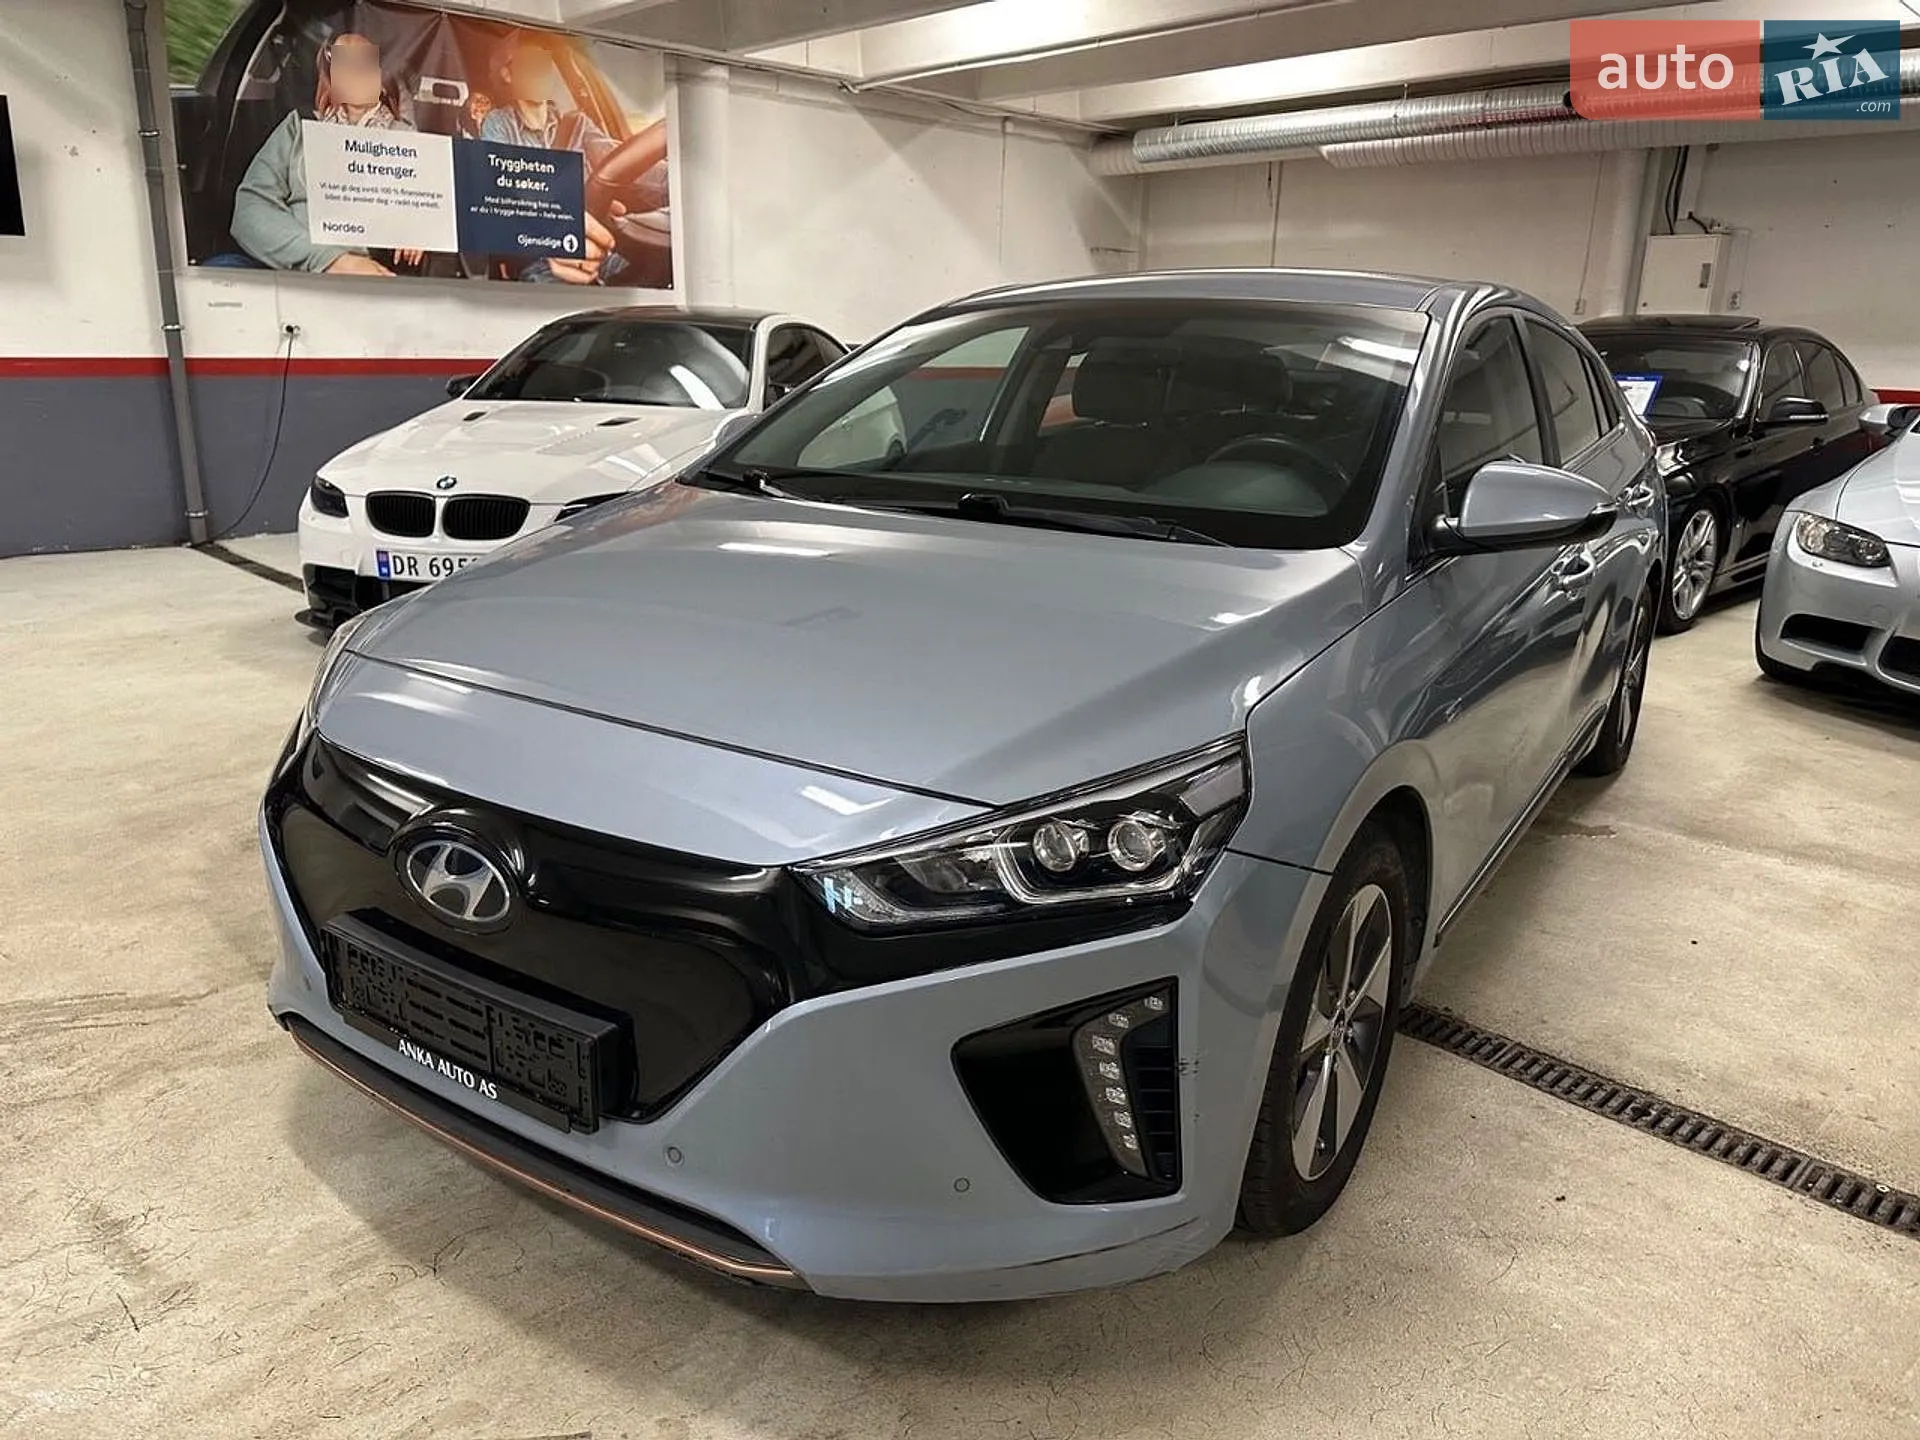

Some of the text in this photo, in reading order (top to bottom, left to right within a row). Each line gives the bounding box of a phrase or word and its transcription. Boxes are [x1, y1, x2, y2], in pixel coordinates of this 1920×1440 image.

[345, 139, 417, 157] Muligheten
[347, 161, 417, 179] du trenger.
[487, 154, 555, 173] Tryggheten
[496, 174, 550, 193] du søker.
[322, 221, 366, 234] Nordea
[517, 233, 562, 249] Gjensidige
[392, 555, 478, 577] DR 695
[398, 1039, 498, 1099] ANKA AUTO AS
